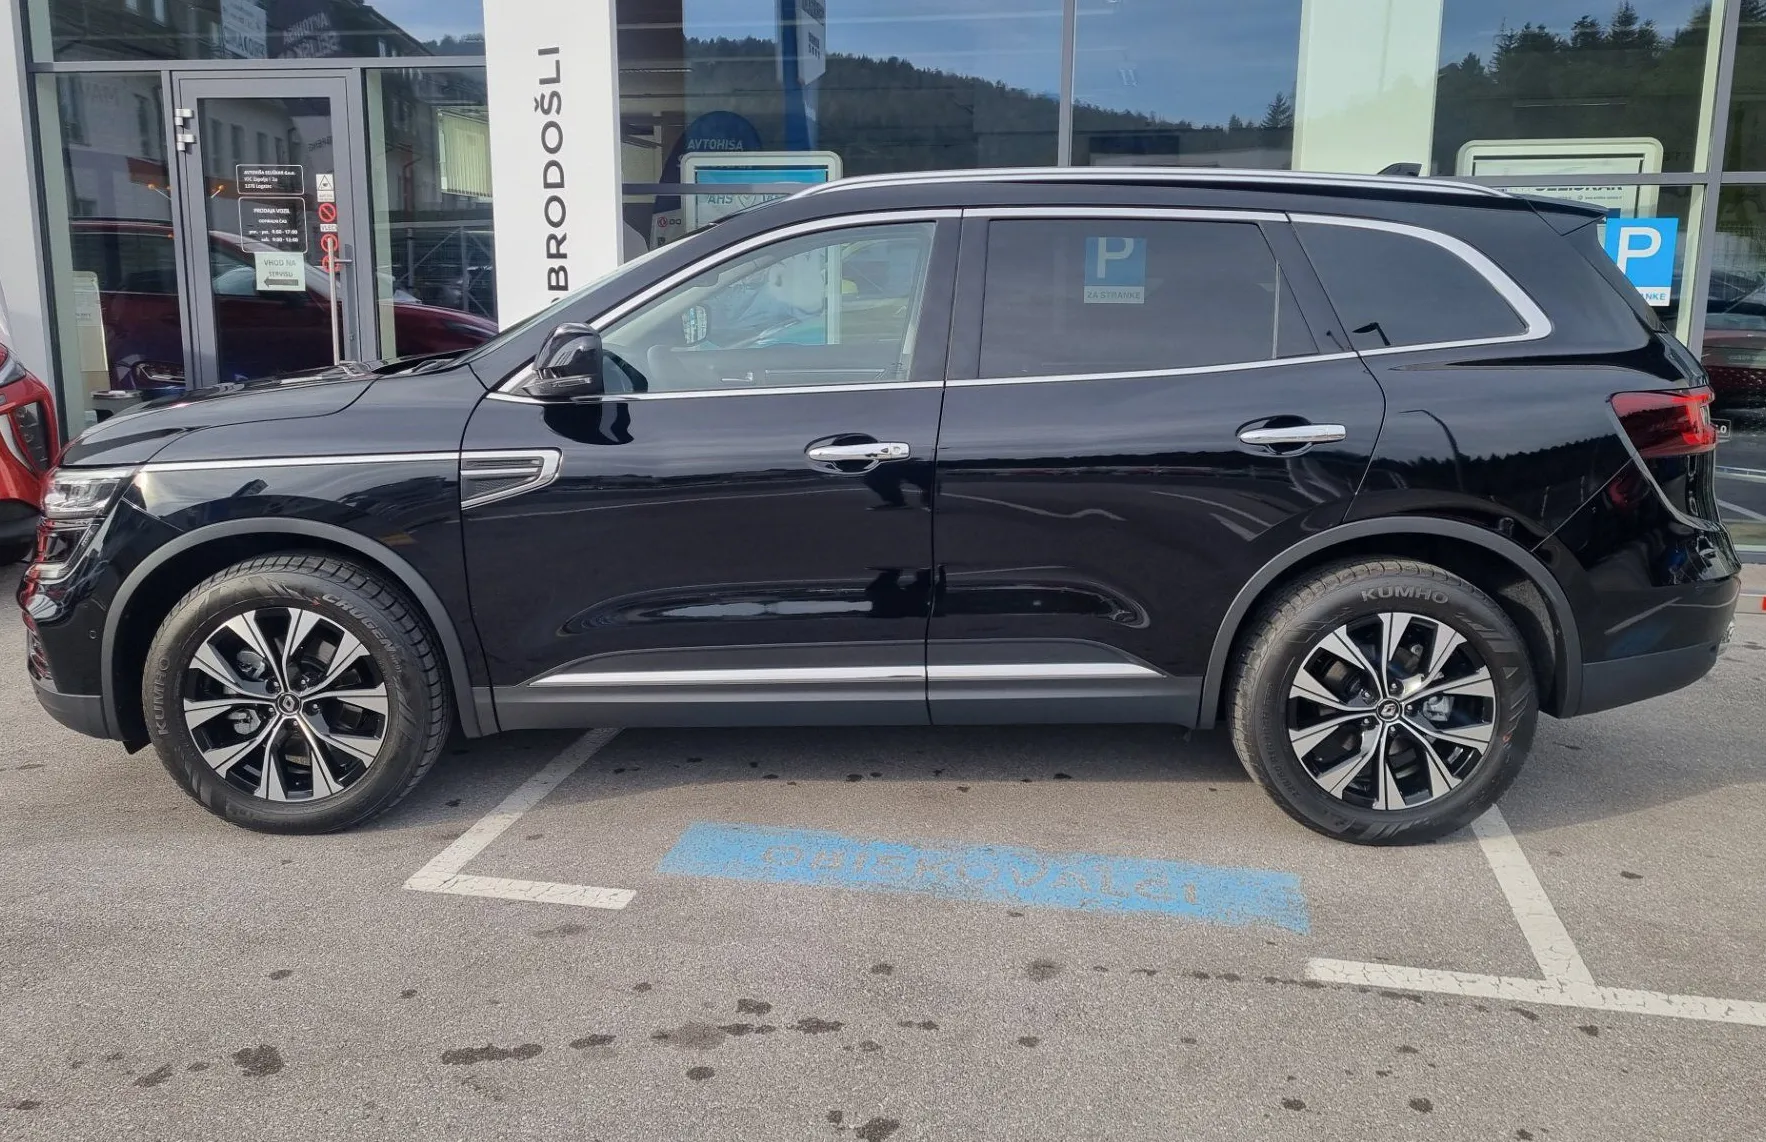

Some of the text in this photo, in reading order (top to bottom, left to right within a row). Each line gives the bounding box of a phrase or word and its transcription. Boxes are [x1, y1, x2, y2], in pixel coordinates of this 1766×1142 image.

[534, 46, 569, 303] BRODOŠLI
[264, 259, 297, 267] VHOD NA
[1097, 236, 1134, 279] P
[1617, 226, 1662, 275] P
[1087, 291, 1140, 299] ZA STRANKE
[1361, 585, 1449, 604] KUMHO
[322, 593, 397, 652] CRUGEN
[153, 657, 169, 735] KUMHO
